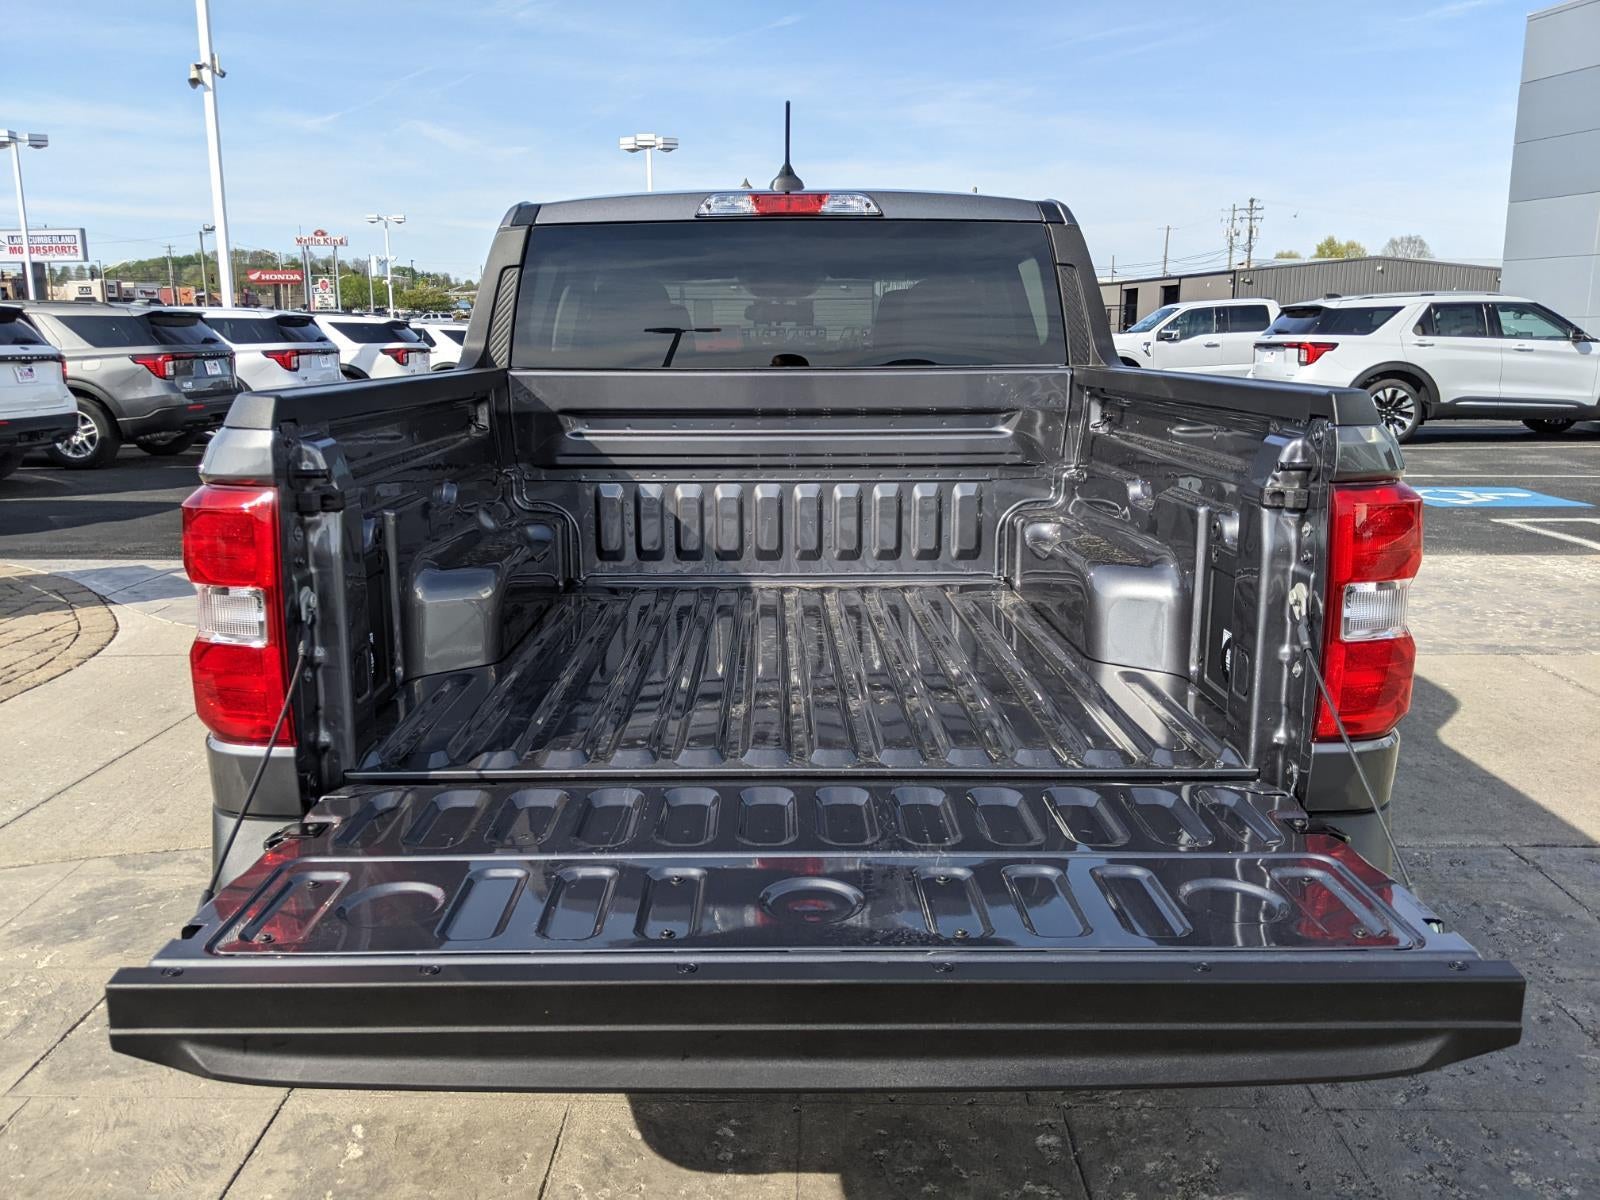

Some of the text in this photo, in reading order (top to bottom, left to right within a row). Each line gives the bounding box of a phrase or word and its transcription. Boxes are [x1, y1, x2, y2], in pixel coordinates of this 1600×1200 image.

[9, 235, 75, 245] LAK CUMBERLAND
[295, 236, 321, 245] Waffle
[9, 246, 78, 255] MOORSPORTS
